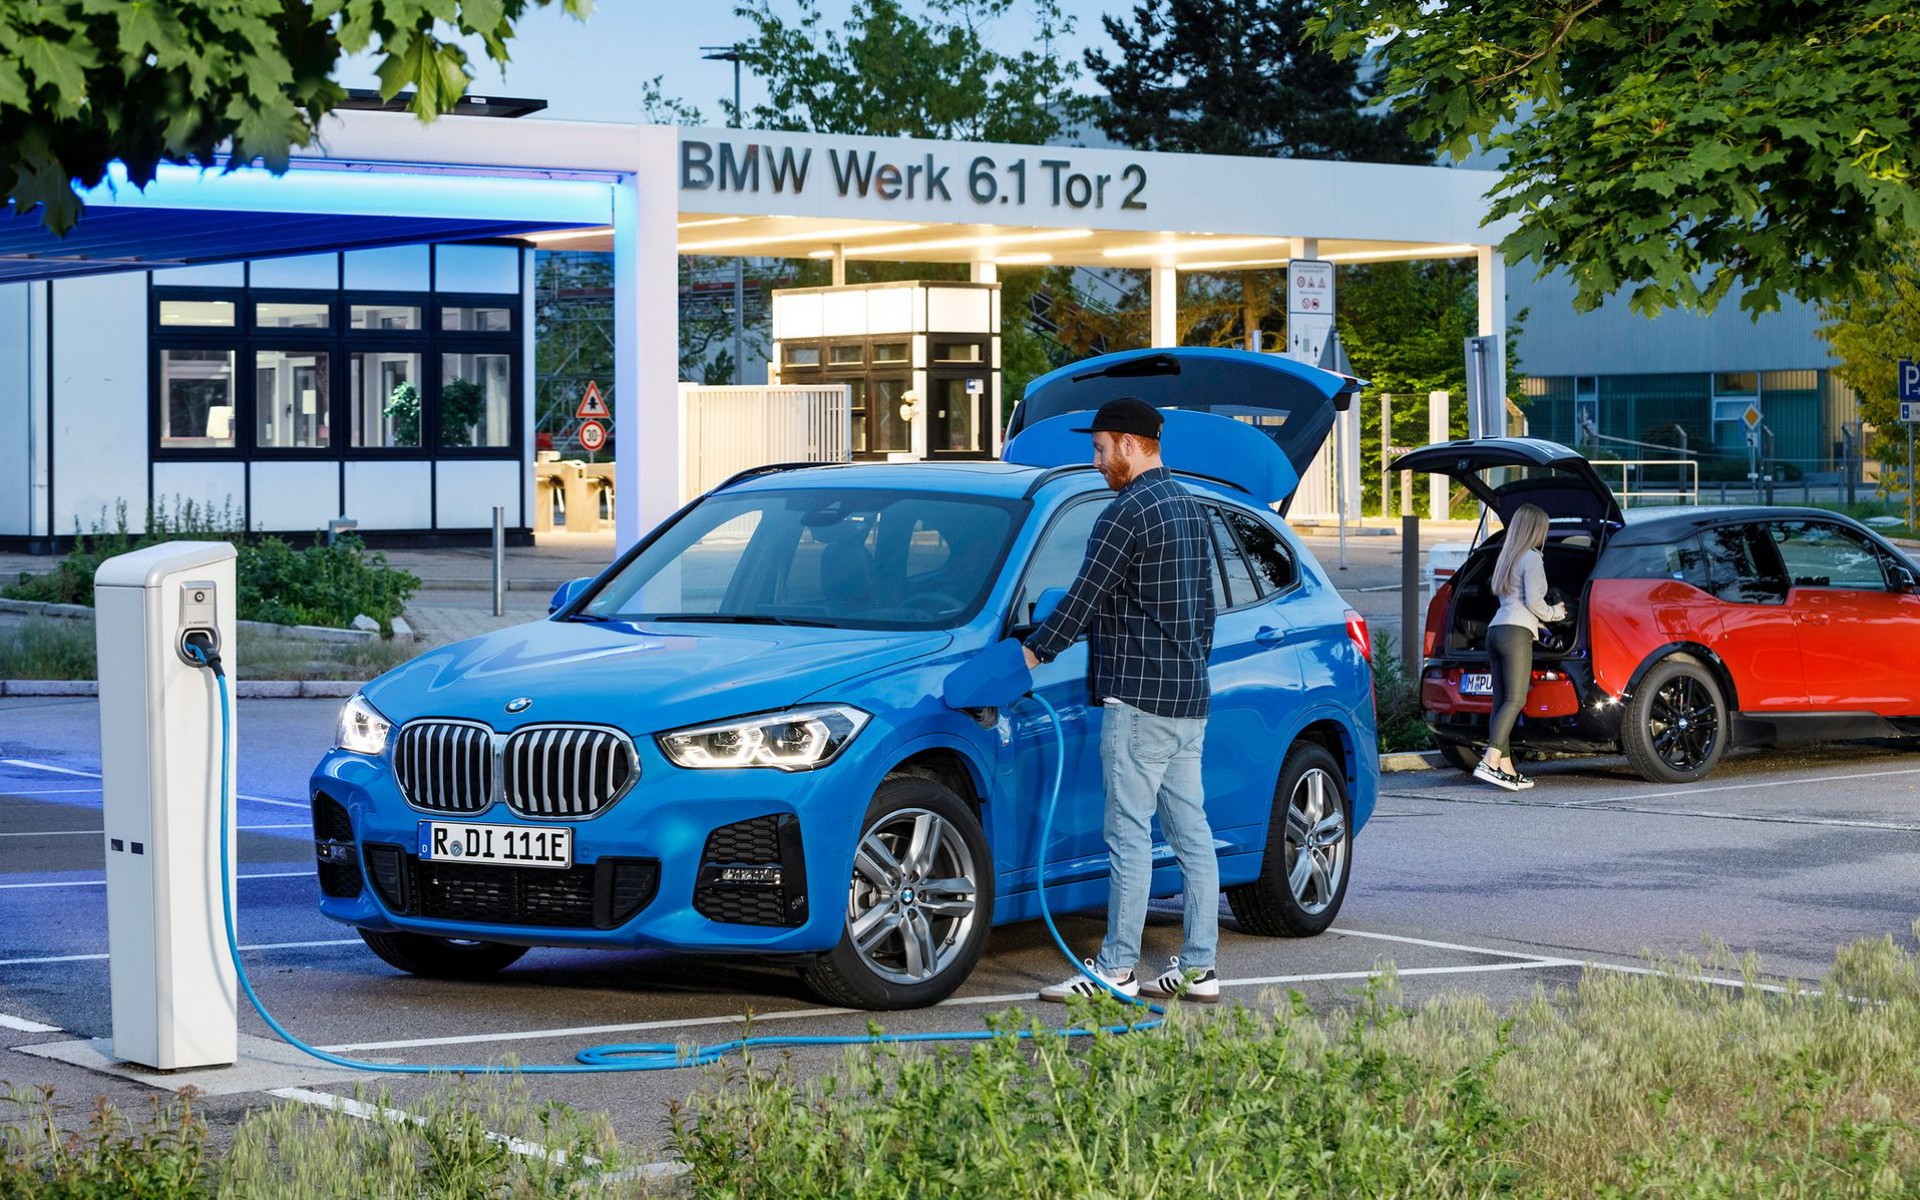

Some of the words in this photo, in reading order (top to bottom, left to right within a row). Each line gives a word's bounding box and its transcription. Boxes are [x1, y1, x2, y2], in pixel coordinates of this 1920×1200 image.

[679, 139, 813, 195] BMW
[828, 148, 953, 201] Werk
[967, 155, 1027, 205] 6.1
[1039, 159, 1112, 209] Tor
[1120, 163, 1148, 210] 2
[1905, 365, 1920, 395] P
[586, 430, 598, 441] 30
[1467, 676, 1474, 690] M
[434, 828, 448, 855] R
[465, 828, 495, 858] DI
[503, 831, 565, 861] 111E
